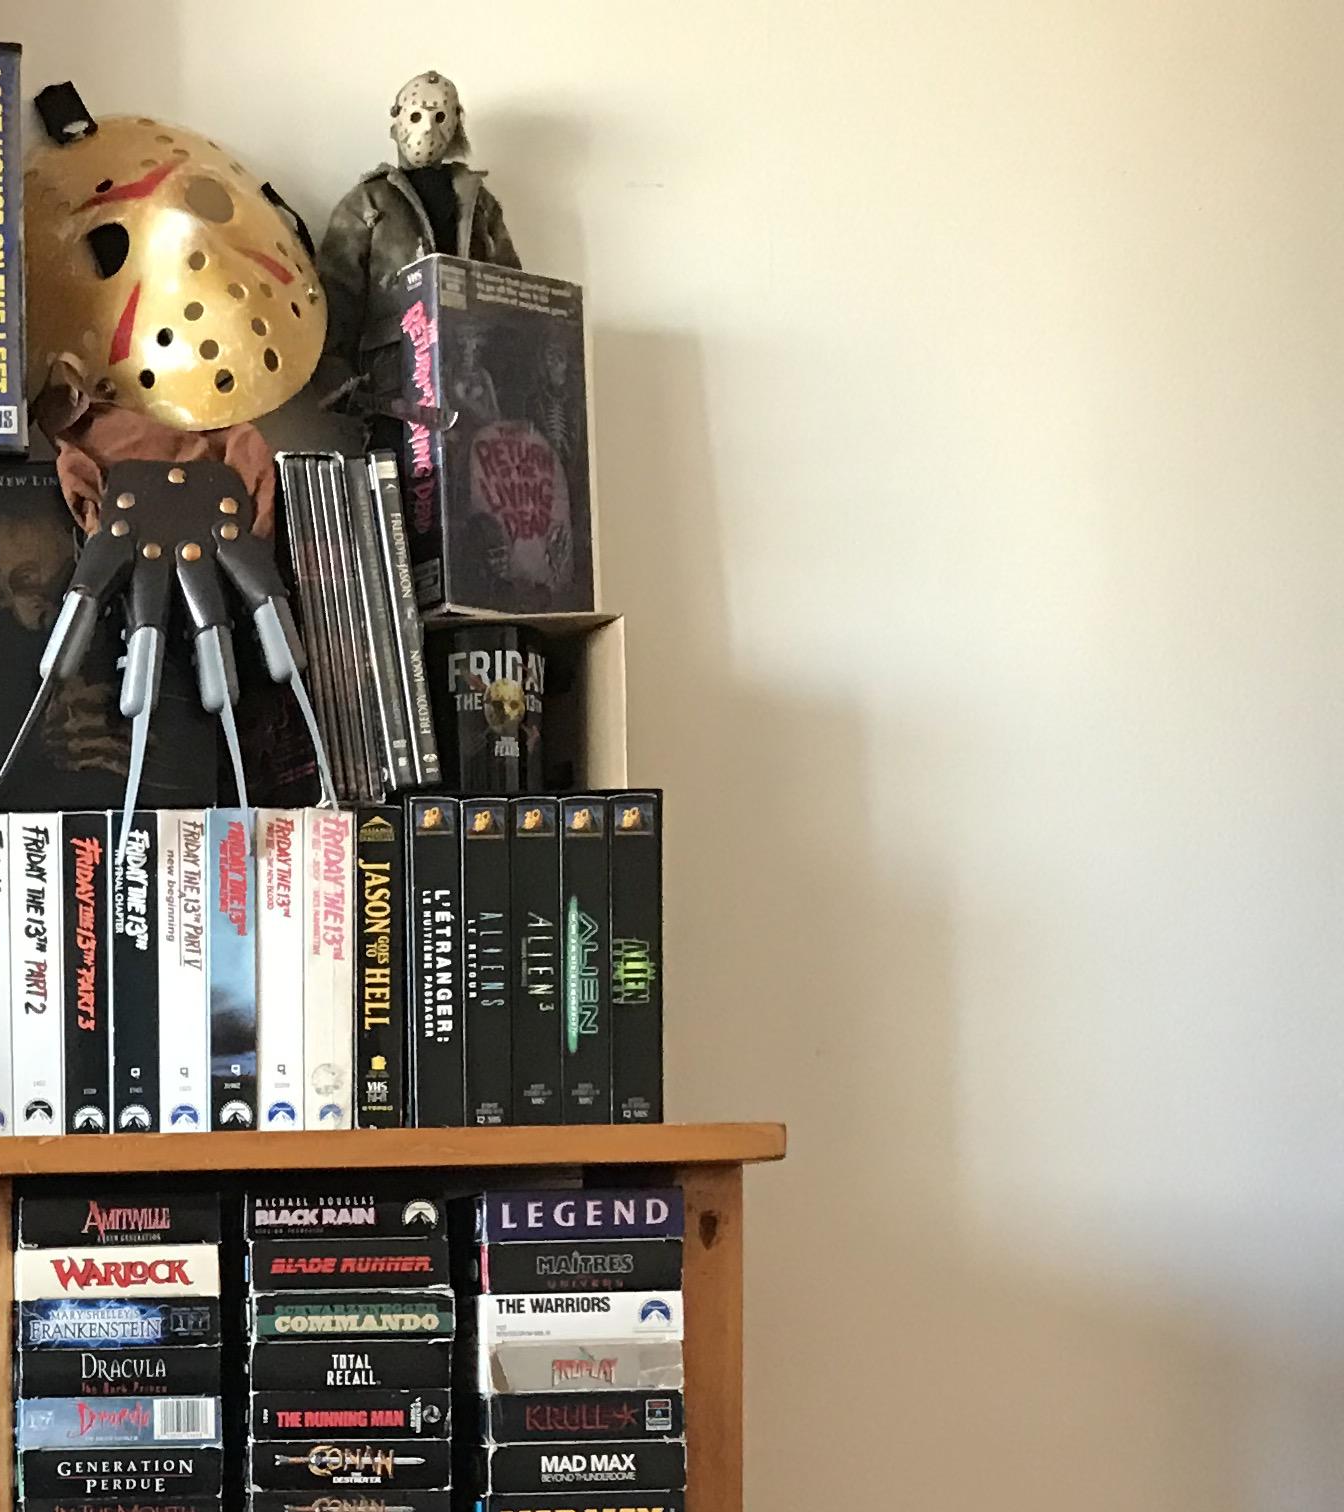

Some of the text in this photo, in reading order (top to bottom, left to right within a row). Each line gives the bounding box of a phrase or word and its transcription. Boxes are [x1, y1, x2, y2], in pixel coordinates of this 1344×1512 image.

[359, 857, 391, 933] JASON
[364, 968, 391, 1032] HELL
[501, 1201, 669, 1228] LEGEND
[496, 1297, 610, 1314] THE WARRIORS
[331, 1354, 371, 1370] TOTAL
[327, 1370, 379, 1387] RECALL
